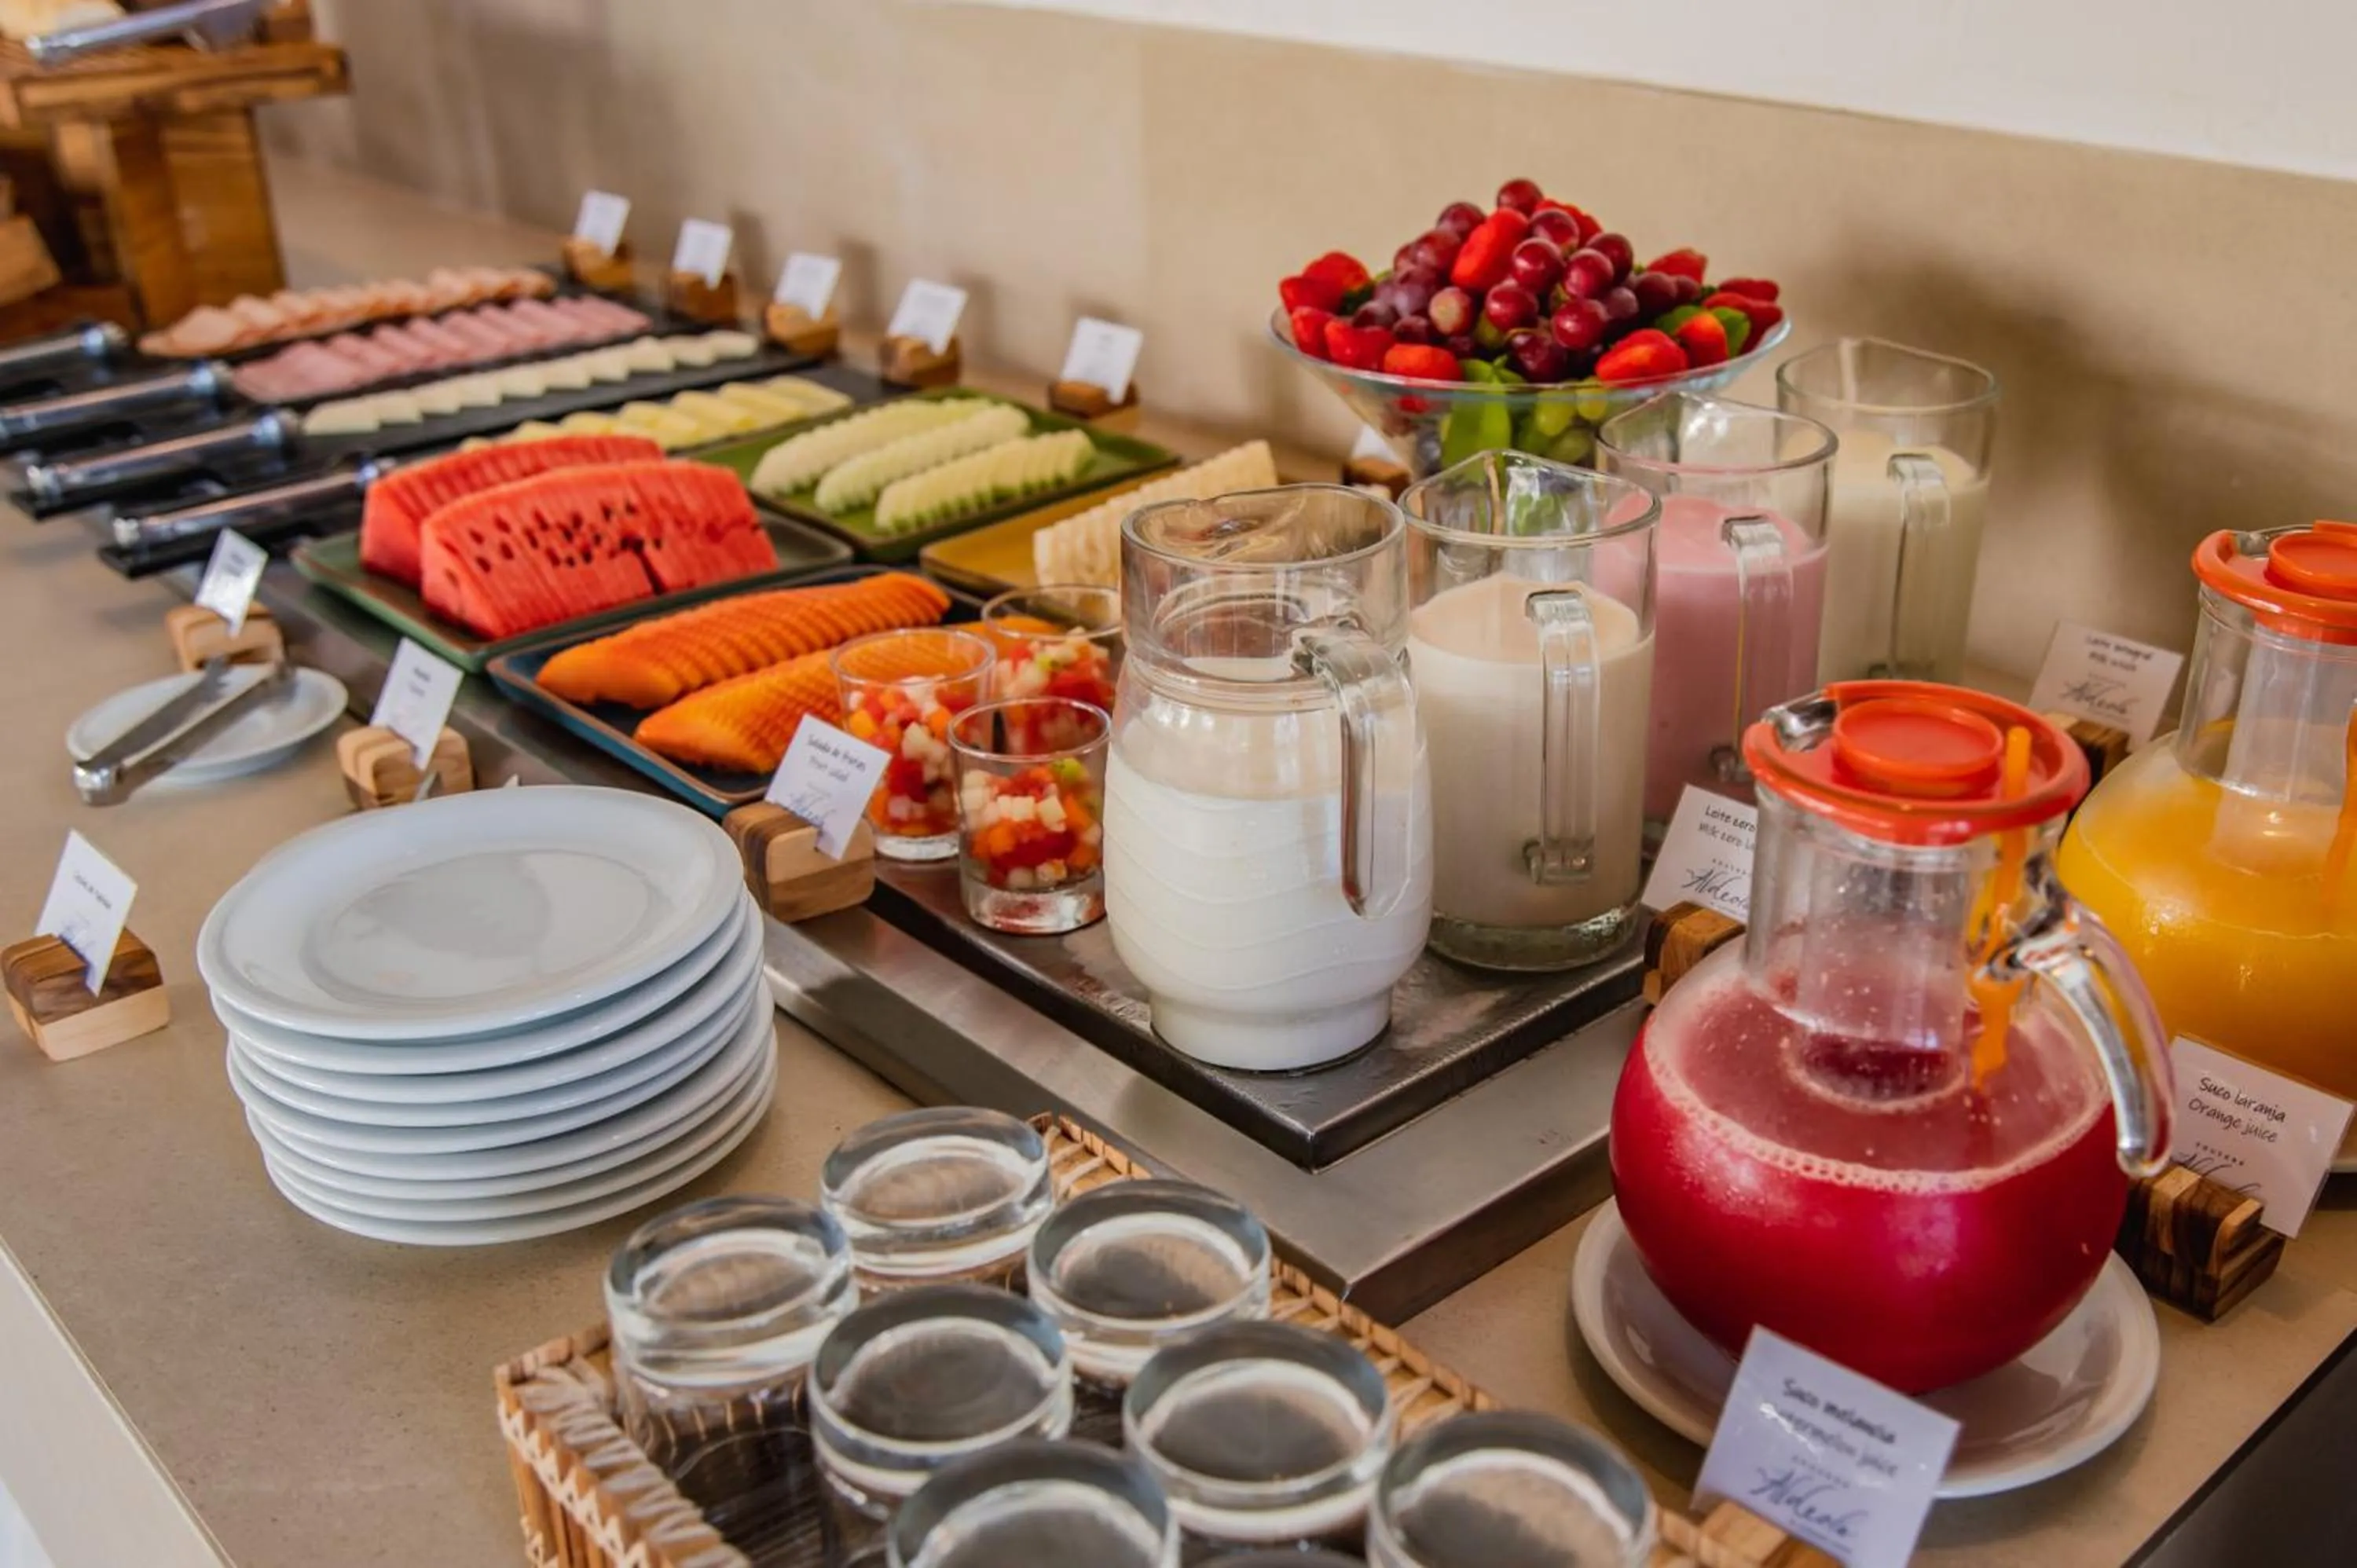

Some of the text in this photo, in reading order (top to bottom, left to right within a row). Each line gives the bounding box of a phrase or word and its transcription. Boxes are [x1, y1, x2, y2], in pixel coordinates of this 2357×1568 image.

[1704, 804, 1732, 823] Leite
[2199, 1077, 2286, 1123] Suco laranja
[2188, 1097, 2278, 1143] Orange juice
[1782, 1376, 1820, 1409] Suco
